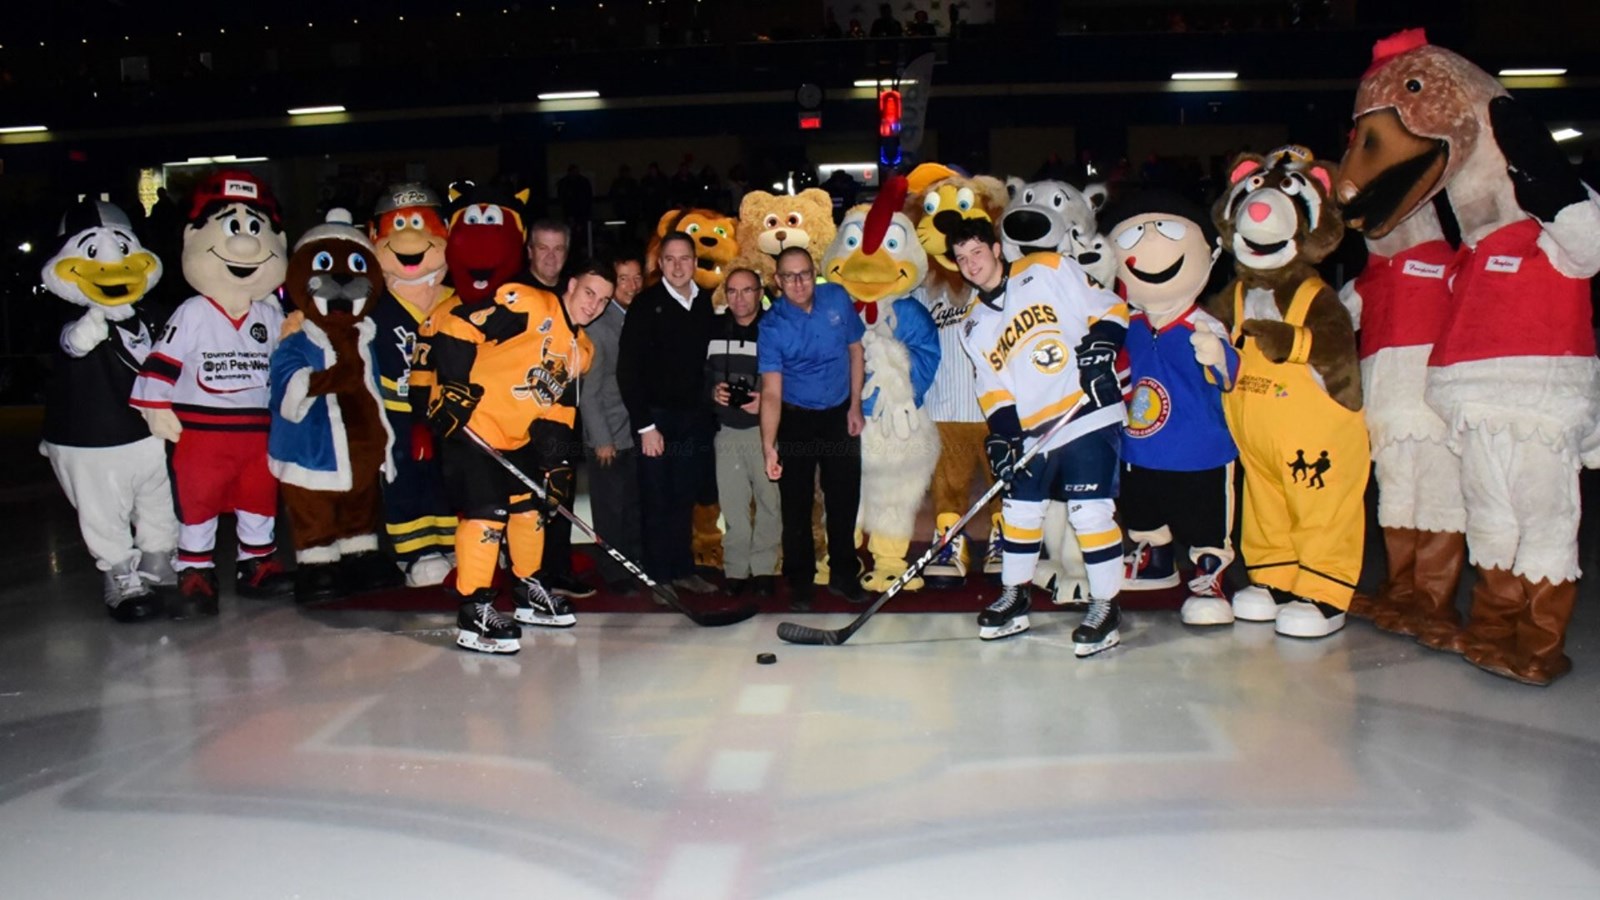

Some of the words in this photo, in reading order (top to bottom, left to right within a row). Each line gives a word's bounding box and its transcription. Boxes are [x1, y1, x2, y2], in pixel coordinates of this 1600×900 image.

[984, 304, 1058, 372] STACADES
[1078, 353, 1111, 367] CM
[1064, 483, 1099, 492] CCM
[607, 548, 657, 586] CCM
[887, 549, 932, 598] CCM
